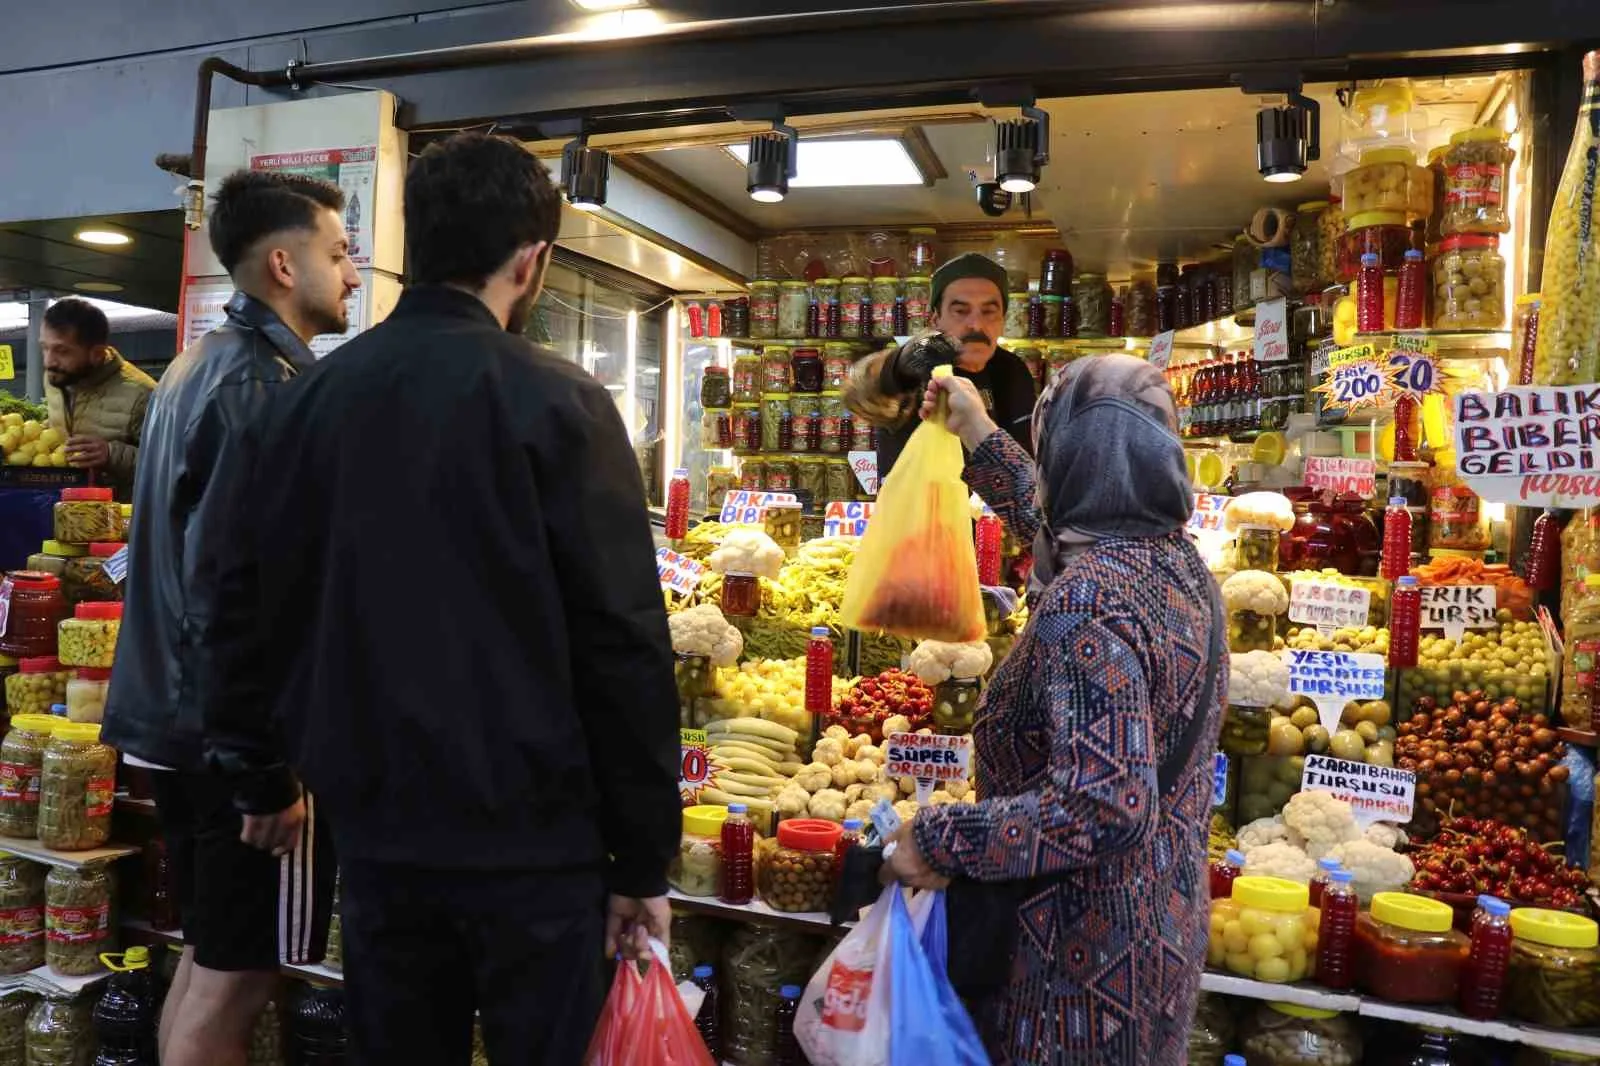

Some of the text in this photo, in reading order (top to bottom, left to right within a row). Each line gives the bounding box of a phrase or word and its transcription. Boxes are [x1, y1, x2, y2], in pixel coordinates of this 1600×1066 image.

[1335, 374, 1380, 402] 200
[1458, 387, 1600, 422] BALIK
[1419, 587, 1485, 605] ERIK
[681, 749, 708, 783] 0
[888, 746, 959, 765] SÜPER
[1304, 771, 1406, 798] TURŞUSU
